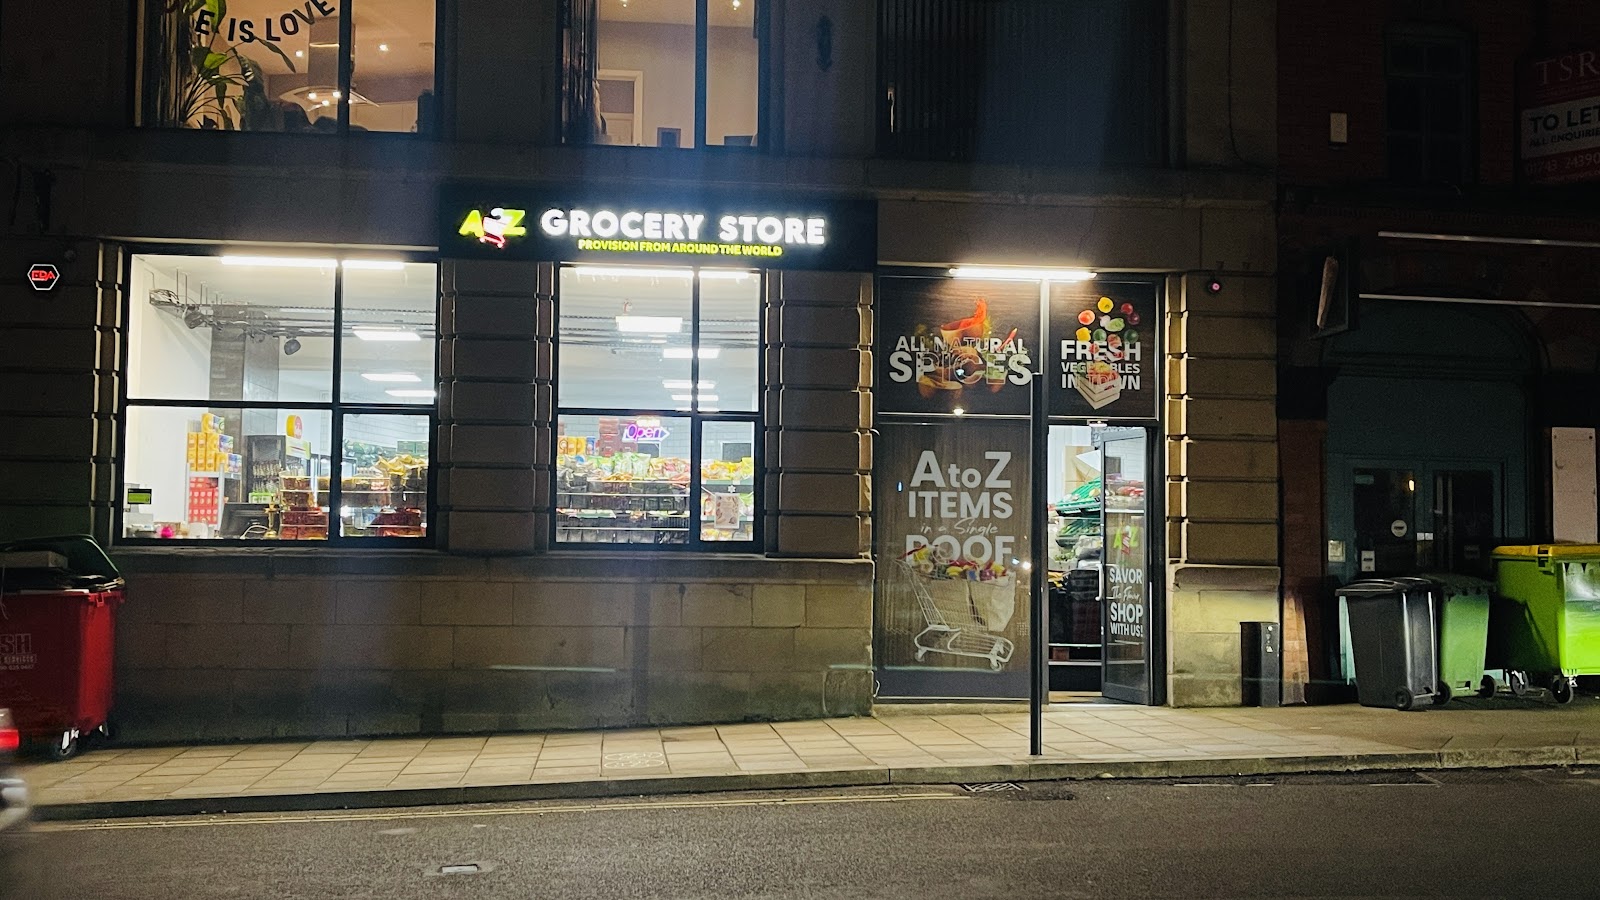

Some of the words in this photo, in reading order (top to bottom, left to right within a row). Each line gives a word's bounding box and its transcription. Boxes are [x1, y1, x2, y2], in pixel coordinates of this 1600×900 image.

[228, 18, 256, 43] IS
[265, 0, 335, 42] LOVE
[1529, 114, 1559, 133] TO
[1529, 137, 1548, 148] ALL
[540, 208, 704, 241] GROCERY
[718, 214, 826, 246] STORE
[577, 239, 639, 252] PROVISION
[639, 241, 671, 253] FROM
[671, 242, 719, 255] AROUND
[719, 244, 742, 256] THE
[742, 245, 783, 257] WORLD
[895, 335, 930, 353] ALL
[933, 336, 1028, 355] NATURAL
[1061, 340, 1141, 363] FRESH
[889, 351, 1032, 386] SPICES
[1061, 361, 1141, 374] VEGEBLES
[627, 423, 661, 442] Open
[910, 450, 946, 488] A
[948, 463, 982, 489] to
[984, 451, 1012, 489] Z
[908, 491, 1013, 519] ITEMS
[920, 522, 933, 534] in
[938, 526, 948, 534] a
[953, 516, 999, 537] Single
[1109, 567, 1143, 585] SAVOR
[1110, 601, 1144, 624] SHOP
[1110, 621, 1129, 636] WITH
[1130, 623, 1144, 638] US!
